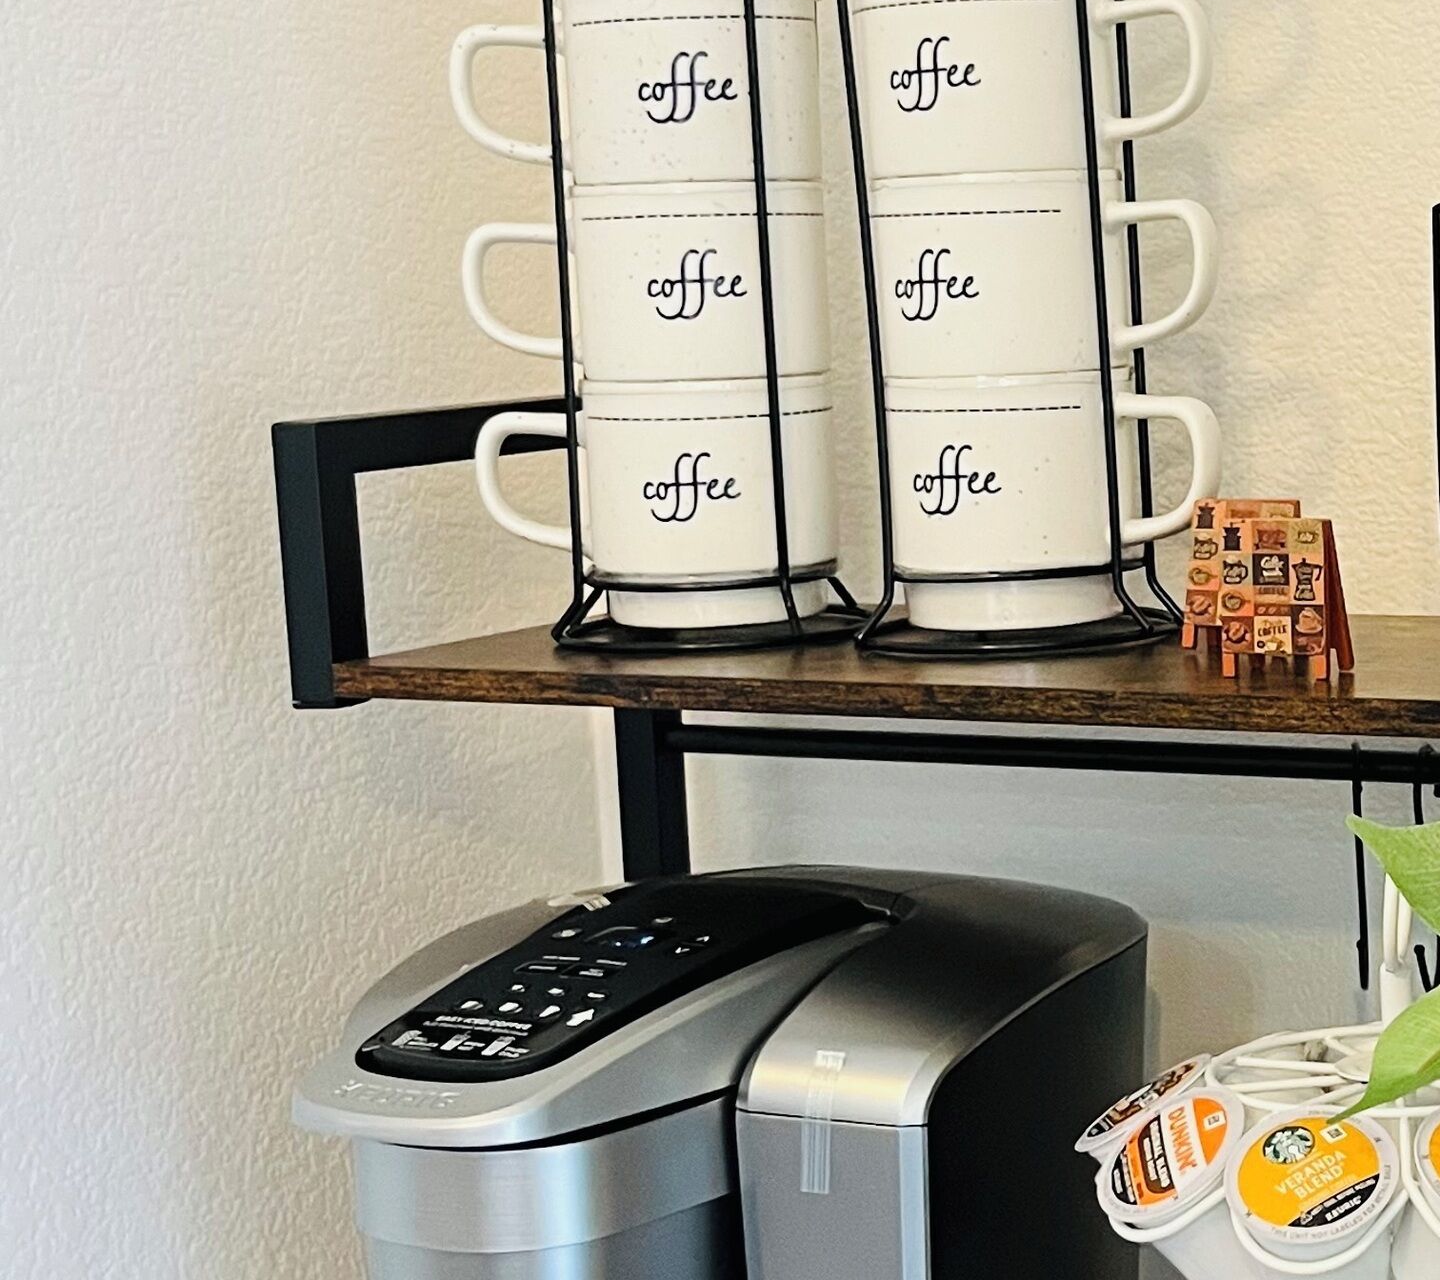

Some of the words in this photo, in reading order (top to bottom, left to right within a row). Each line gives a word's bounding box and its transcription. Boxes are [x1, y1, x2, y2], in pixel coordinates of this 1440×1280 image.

[638, 51, 738, 124] coffee
[890, 36, 982, 113] coffee
[647, 249, 748, 321] coffee
[895, 249, 980, 322] coffee
[643, 452, 742, 523] coffee
[913, 444, 1002, 516] coffee
[1273, 1150, 1347, 1195] VERANDA
[1293, 1165, 1345, 1200] BLEND
